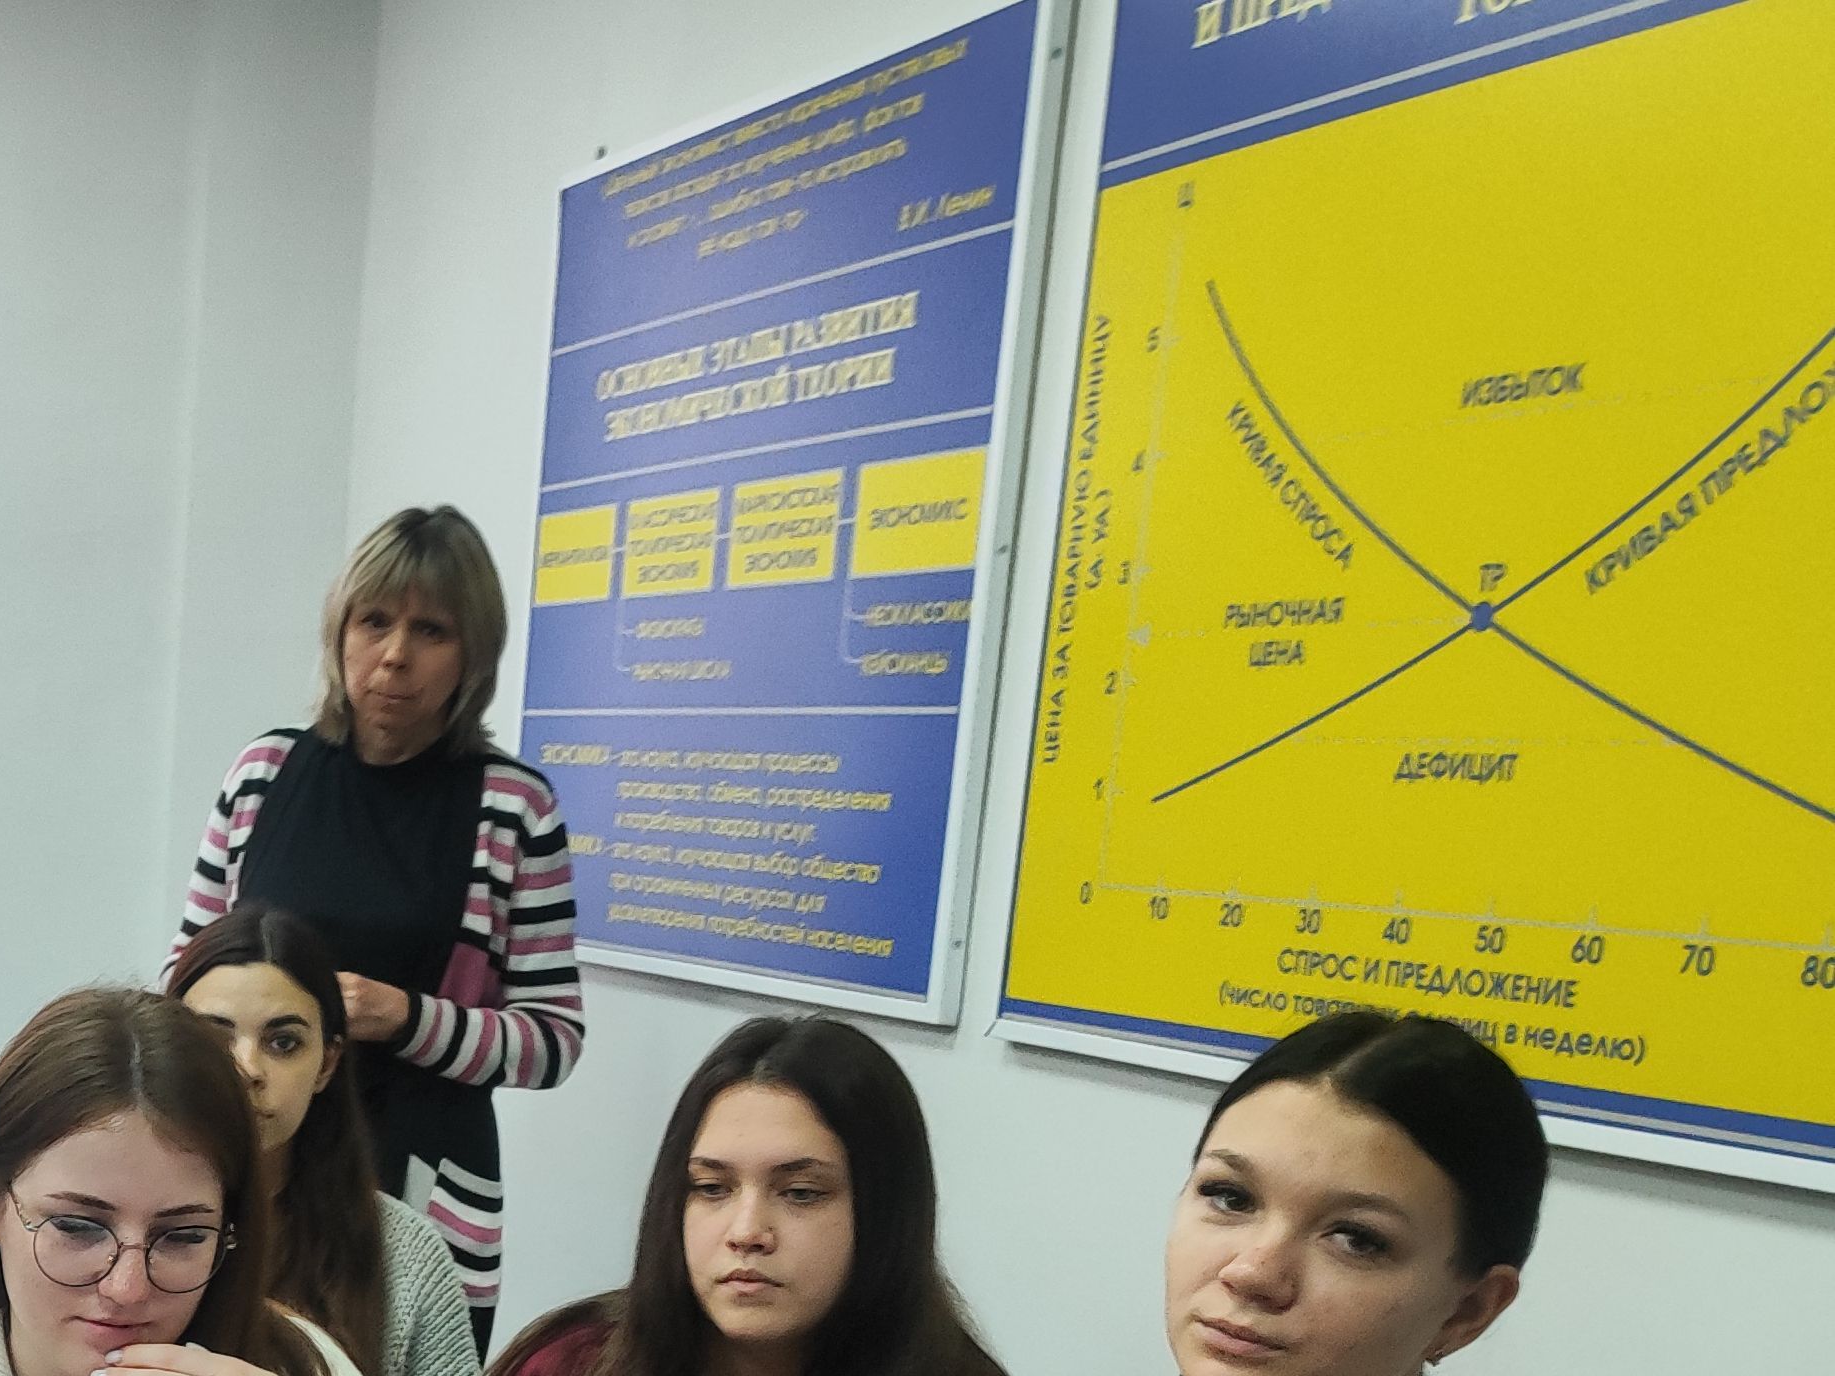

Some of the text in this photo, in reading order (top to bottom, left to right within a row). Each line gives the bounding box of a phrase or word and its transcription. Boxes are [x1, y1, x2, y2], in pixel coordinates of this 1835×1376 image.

[788, 287, 920, 356] РАЗВИТИЯ
[793, 345, 897, 403] ТЕОРИИ
[1459, 362, 1588, 409] ИЗБЫТОК
[1058, 469, 1092, 634] ТОВАРНУЮ
[1279, 478, 1355, 571] СПРОСА
[1584, 492, 1701, 596] КРИВАЯ
[1224, 597, 1346, 629] РЫНОЧНАЯ
[1051, 643, 1072, 680] ЗА
[1104, 670, 1117, 695] 2
[1248, 640, 1305, 668] ЦЕНА
[1043, 689, 1065, 763] ЦЕНА
[1394, 753, 1518, 783] ДЕФИЦИТ
[1150, 896, 1169, 919] 10
[1220, 903, 1244, 927] 20
[1296, 908, 1321, 933] 30
[1382, 917, 1411, 944] 40
[1476, 927, 1505, 953] 50
[1572, 936, 1604, 964] 60
[1681, 945, 1715, 975] 70
[1801, 956, 1835, 989] 80
[1277, 949, 1580, 1008] СПРОС И ПРЕДЛОЖЕНИЕ
[1219, 981, 1288, 1010] (число
[1505, 1023, 1517, 1046] в
[1524, 1025, 1647, 1067] неделю)
